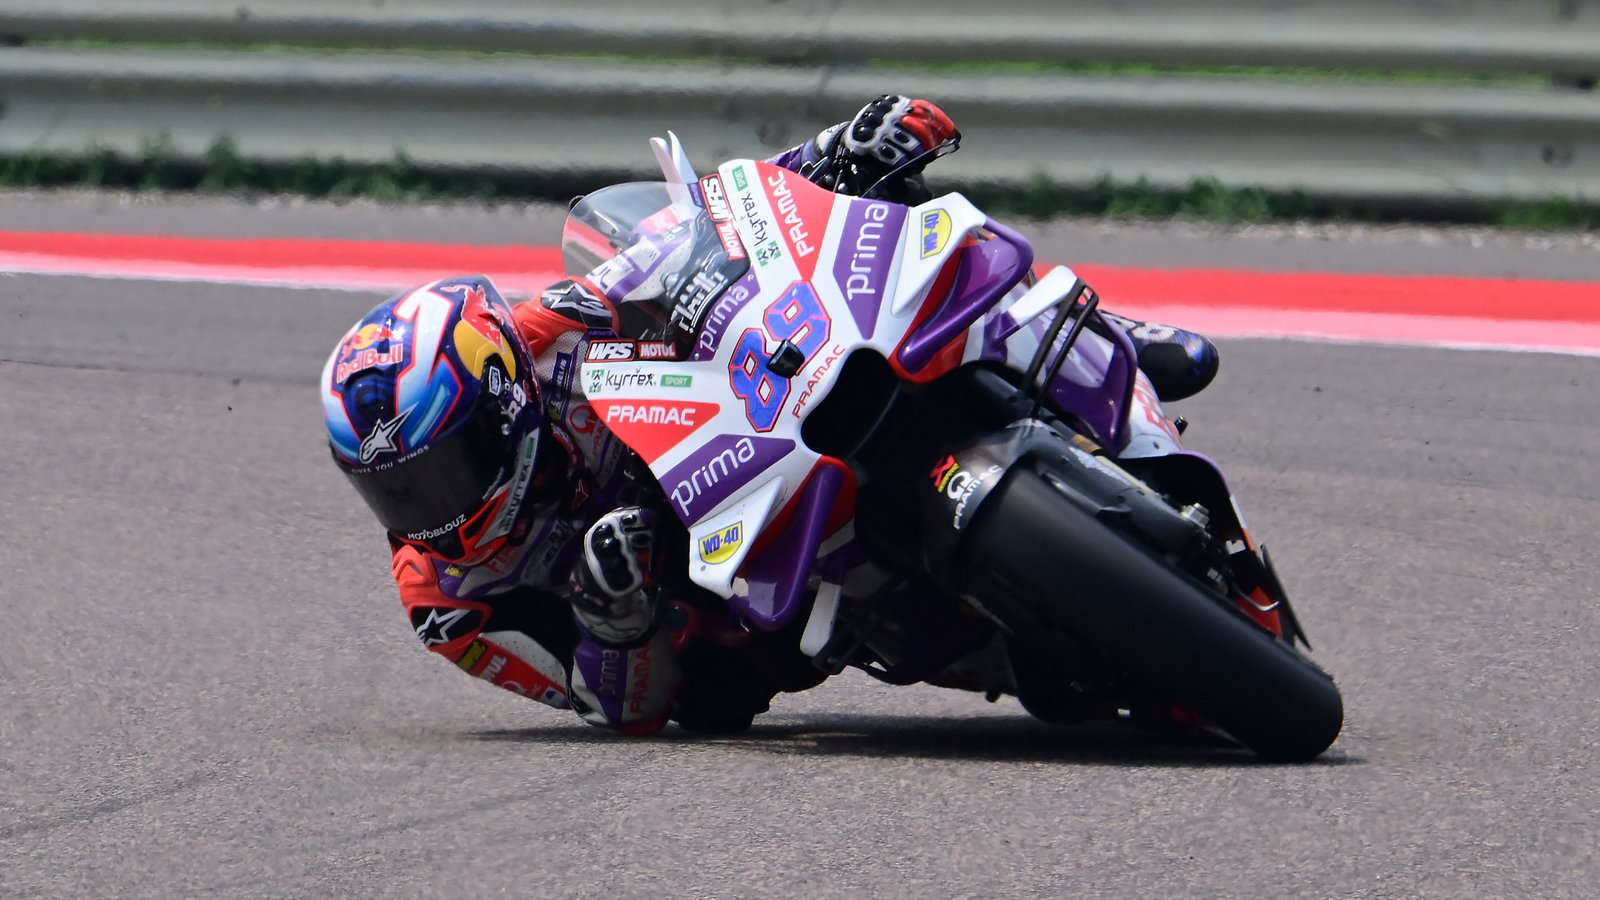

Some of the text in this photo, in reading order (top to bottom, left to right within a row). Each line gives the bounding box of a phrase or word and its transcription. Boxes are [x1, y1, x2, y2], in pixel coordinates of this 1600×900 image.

[703, 178, 729, 220] WRS
[768, 170, 814, 257] PRAMAC
[846, 203, 889, 300] prima
[923, 212, 940, 255] WD-40
[700, 285, 749, 351] prima
[590, 342, 634, 360] WRS
[639, 342, 676, 358] MOTUL
[728, 279, 831, 432] 89
[791, 344, 846, 419] PRAMAC
[606, 404, 696, 426] PRAMAC
[374, 461, 394, 472] YOU
[670, 437, 755, 517] prima
[702, 526, 740, 555] WD-40
